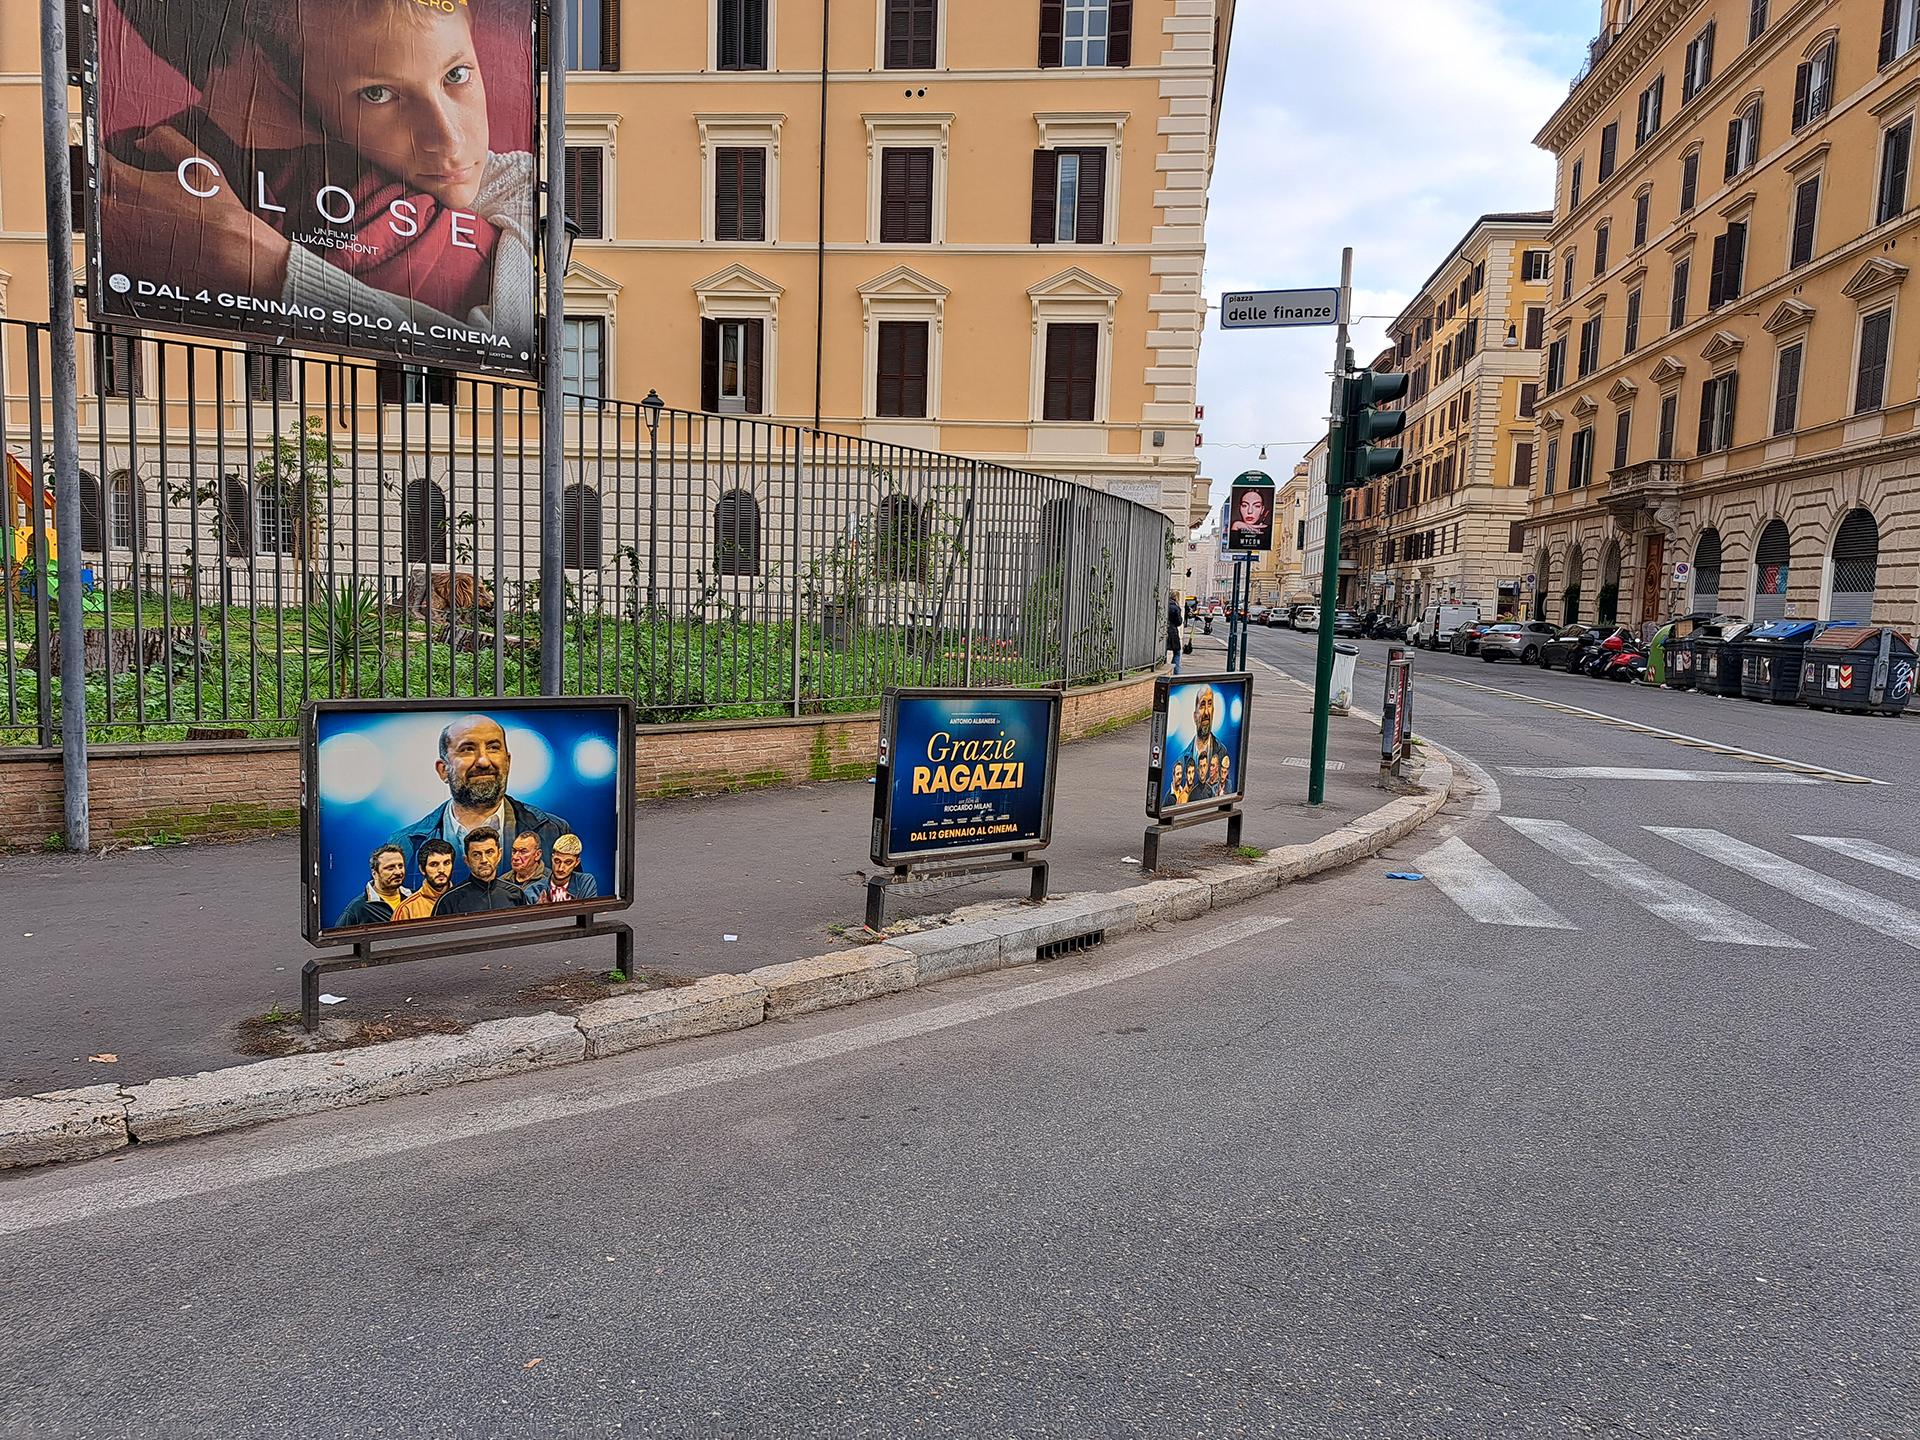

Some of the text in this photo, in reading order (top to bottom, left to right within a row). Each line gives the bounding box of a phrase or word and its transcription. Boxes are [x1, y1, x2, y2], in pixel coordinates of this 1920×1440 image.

[177, 157, 477, 249] CLOSE
[292, 231, 379, 255] LUKAS DHONT
[313, 227, 359, 241] UN FILM DI
[1228, 294, 1254, 303] piazza
[137, 280, 190, 301] DAL
[195, 289, 211, 304] 4
[217, 293, 326, 321] GENNAIO
[332, 310, 393, 331] SOLO
[398, 320, 425, 336] AL
[429, 326, 512, 349] CINEMA
[1228, 305, 1331, 321] delle finanze
[927, 730, 1016, 763] Grazie
[912, 762, 1025, 795] RAGAZZI
[943, 802, 993, 812] RICCARDO MILANI
[910, 823, 1018, 842] DAL 12 GENNAIO AL CINEMA
